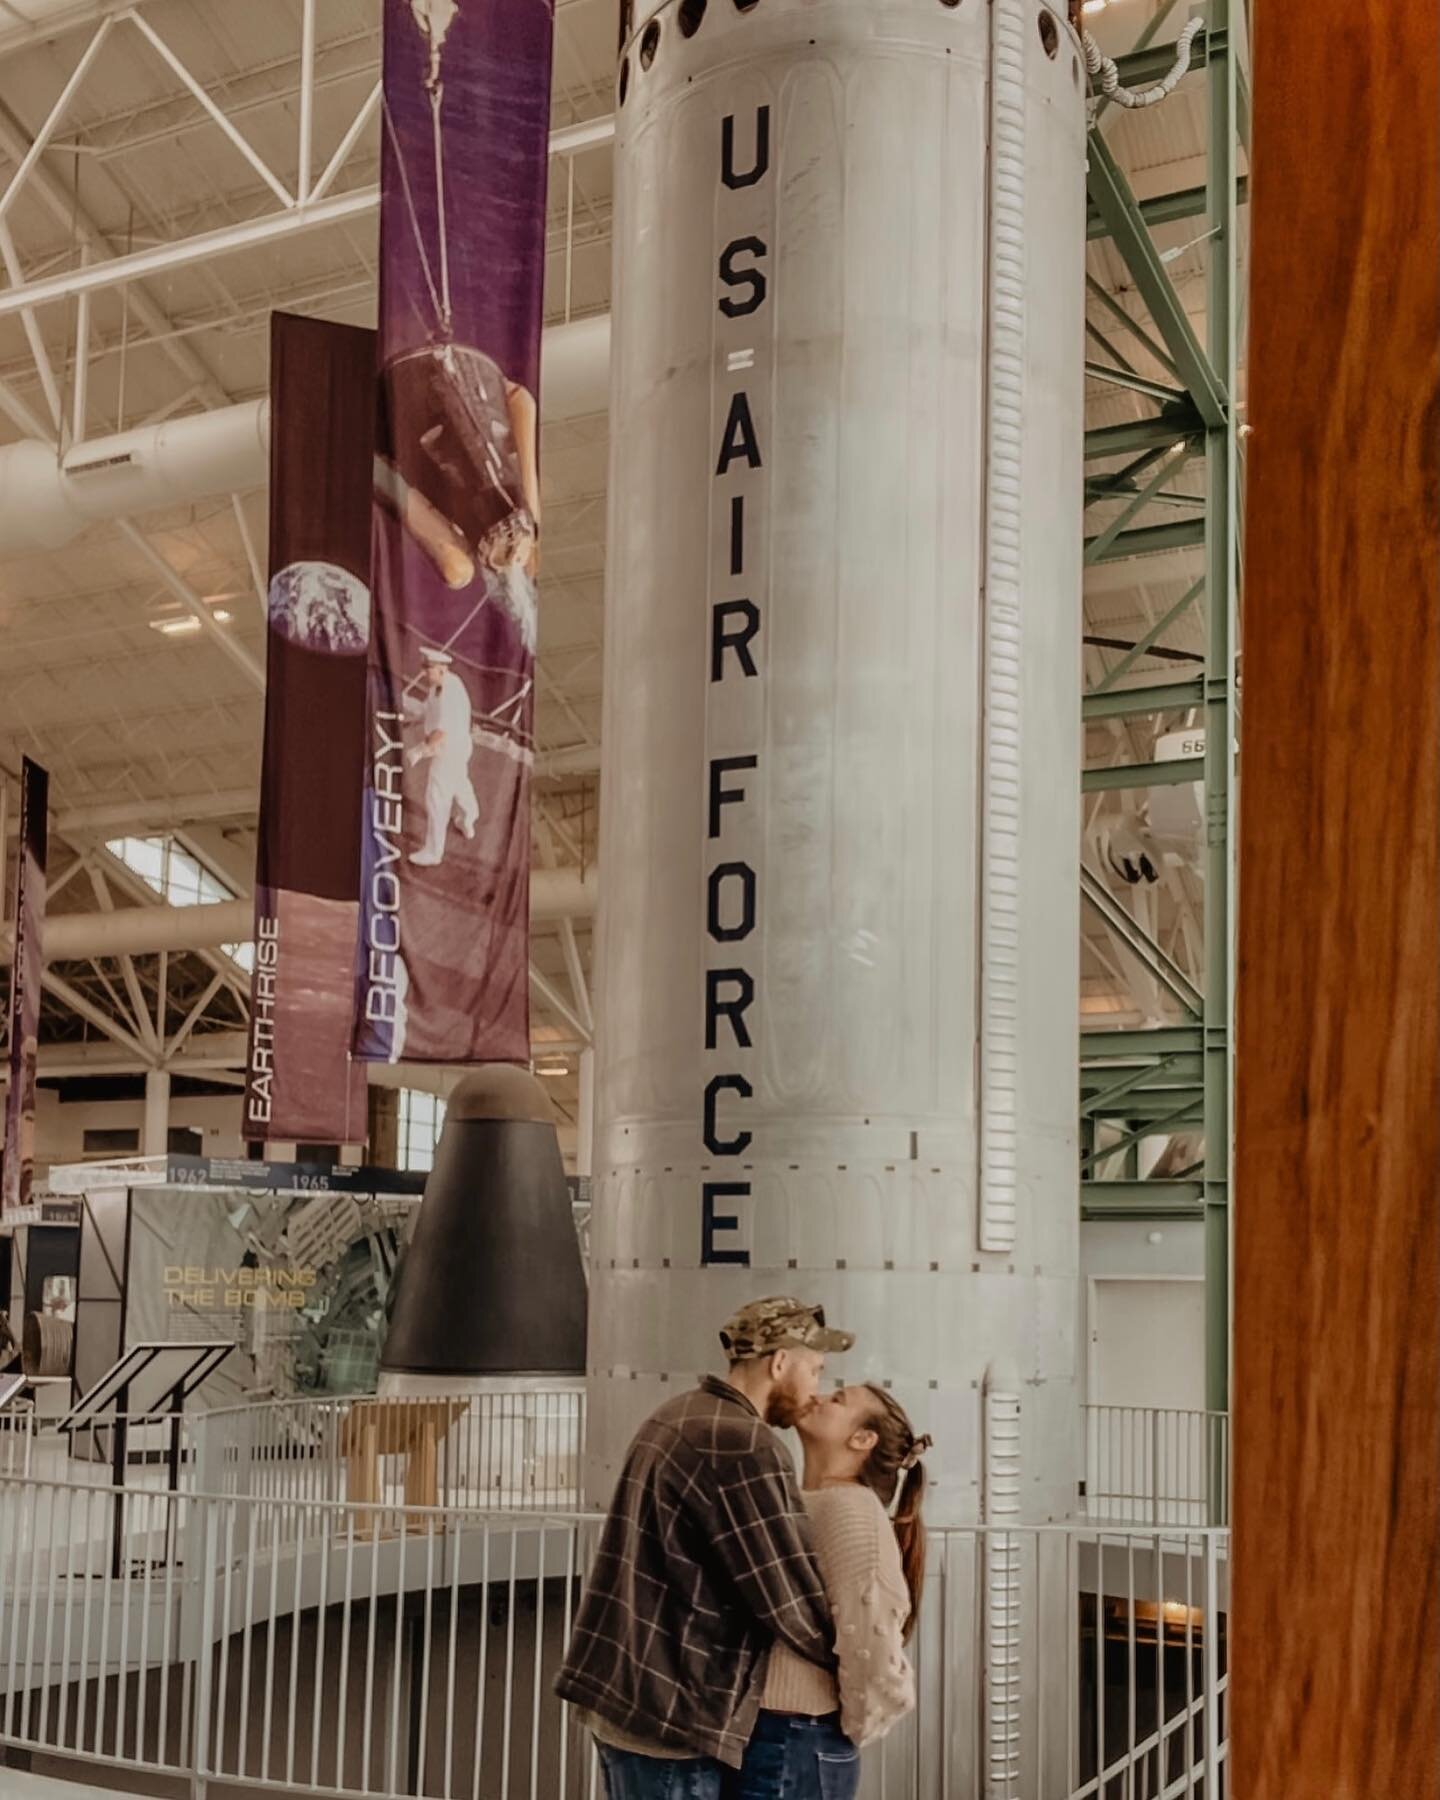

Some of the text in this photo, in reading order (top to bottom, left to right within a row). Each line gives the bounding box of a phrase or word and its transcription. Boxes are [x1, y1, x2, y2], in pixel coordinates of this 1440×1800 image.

[711, 391, 763, 683] AIR
[249, 917, 279, 1122] EARTHRISE
[700, 754, 758, 1266] FORCE
[169, 1167, 208, 1185] 1962
[292, 1174, 329, 1190] 1965
[163, 1266, 317, 1287] DELIVERING
[163, 1288, 306, 1308] THE BOMB
